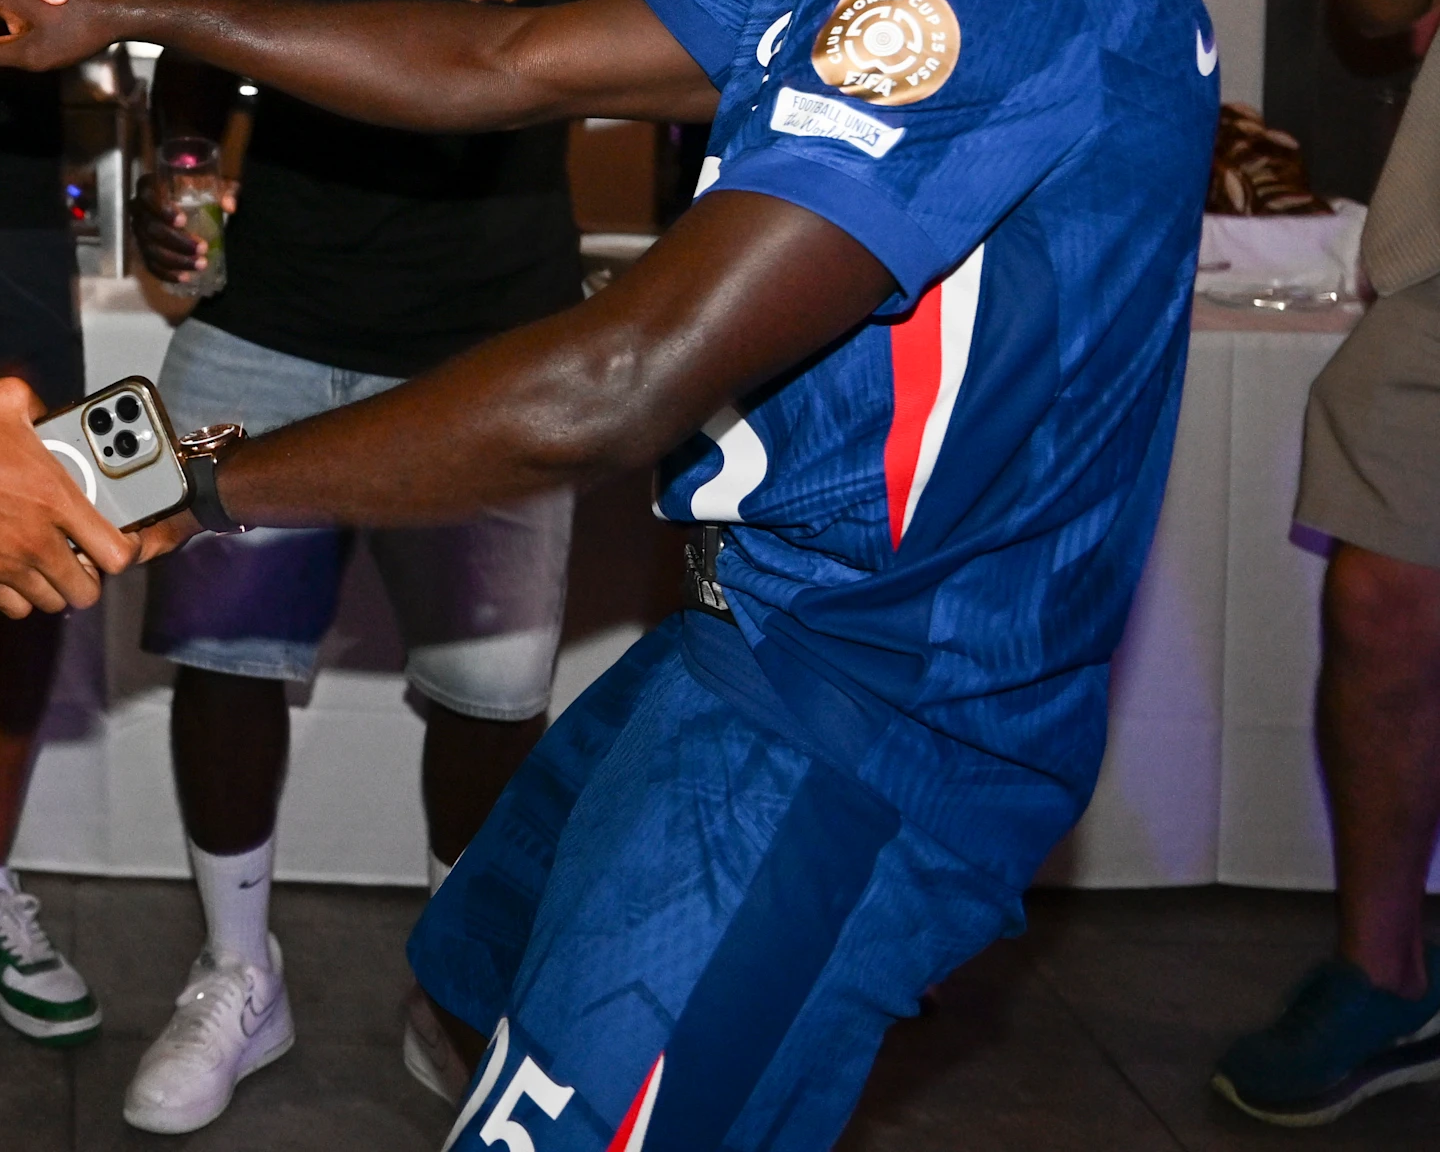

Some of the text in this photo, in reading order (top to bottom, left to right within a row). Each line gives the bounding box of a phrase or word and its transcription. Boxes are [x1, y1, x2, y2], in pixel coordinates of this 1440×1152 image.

[826, 25, 844, 64] CLUB
[931, 31, 946, 53] 25
[843, 70, 894, 97] FIFA
[905, 57, 941, 87] USA
[783, 112, 800, 127] the
[792, 95, 841, 124] FOOTBALL
